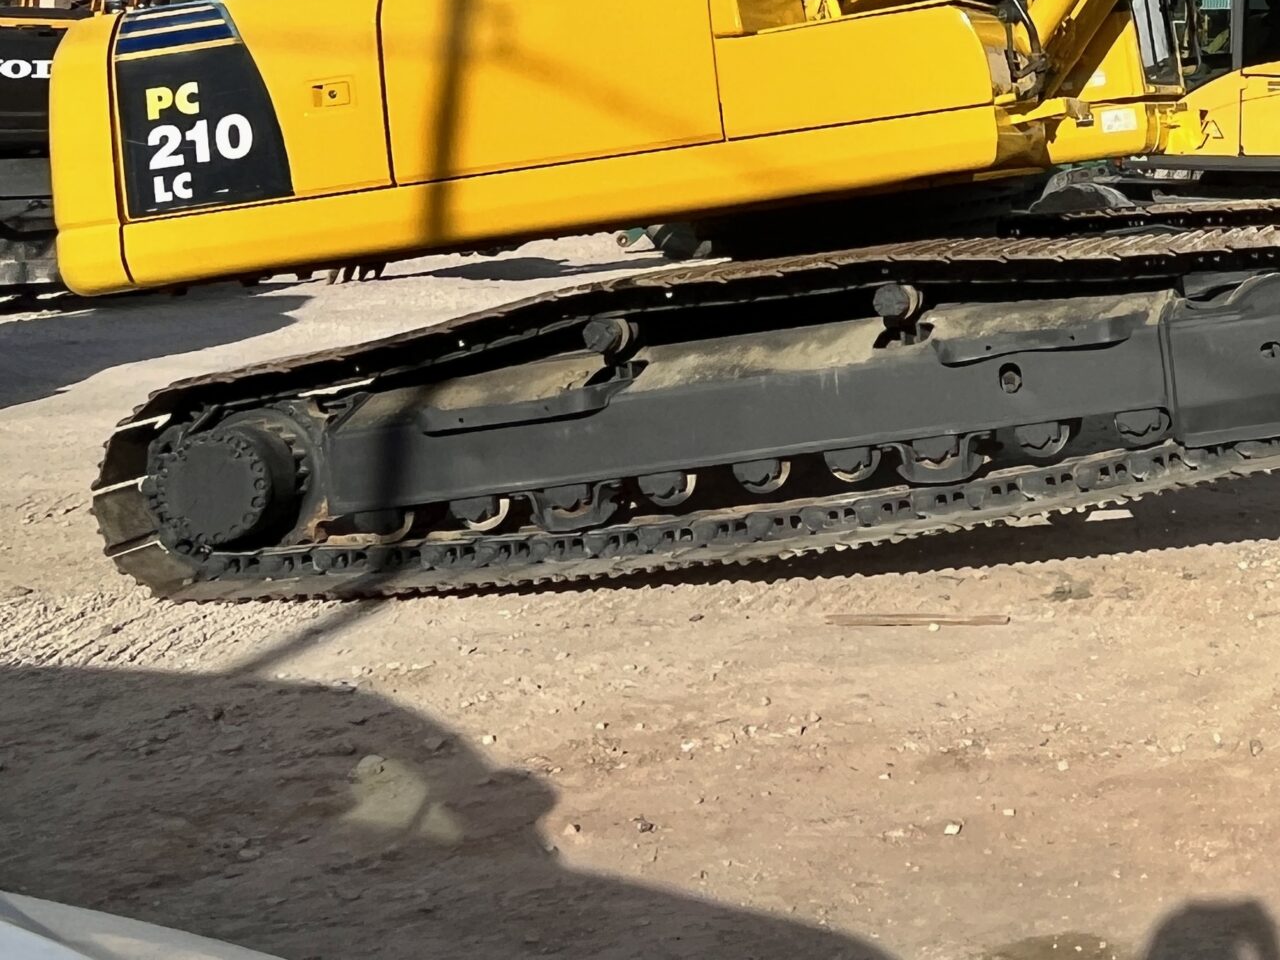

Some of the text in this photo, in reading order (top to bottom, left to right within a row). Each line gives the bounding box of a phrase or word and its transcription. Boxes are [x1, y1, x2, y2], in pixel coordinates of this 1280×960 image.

[145, 81, 200, 121] PC
[147, 113, 254, 170] 210
[153, 171, 193, 203] LC
